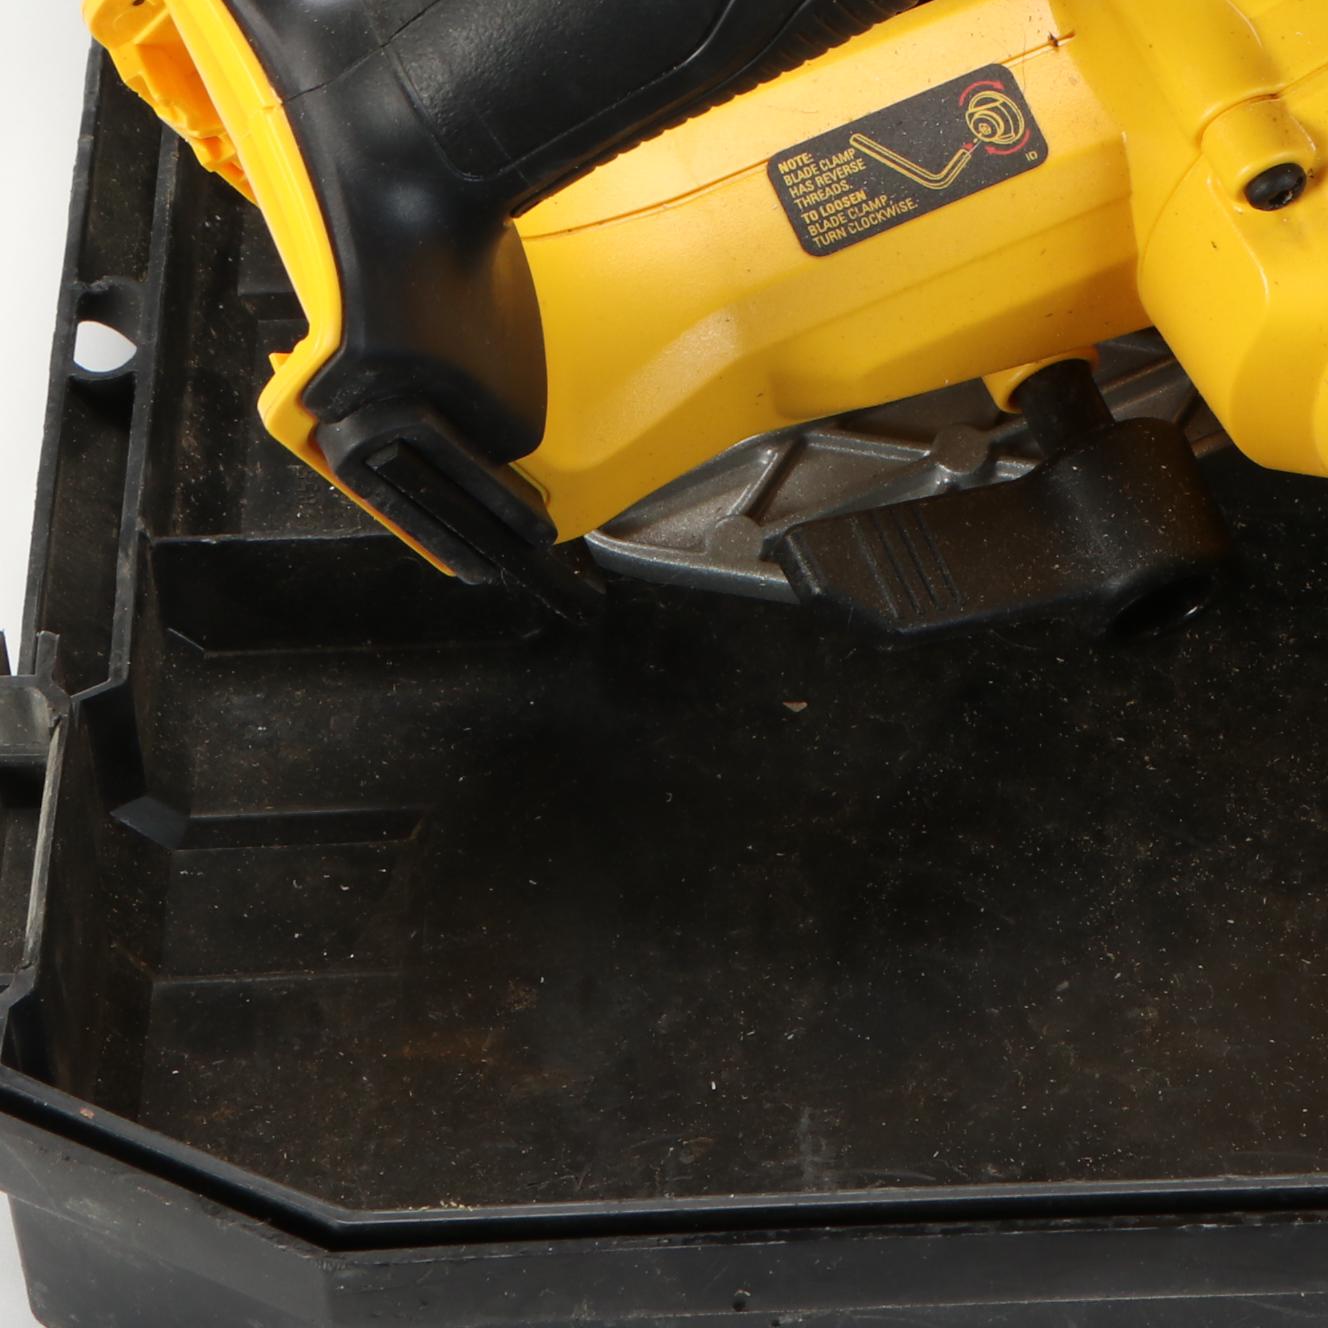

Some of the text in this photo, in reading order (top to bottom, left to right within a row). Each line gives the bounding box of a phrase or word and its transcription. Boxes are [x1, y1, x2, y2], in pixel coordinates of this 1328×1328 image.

[778, 152, 814, 174] NOTE:
[783, 148, 856, 186] BLADE CLAMP
[788, 158, 866, 198] HAS REVERSE
[794, 180, 853, 210] THREADS.
[801, 189, 867, 224] TO LOOSEN
[808, 212, 848, 236] BLADE
[812, 197, 918, 248] TURN CLOCKWISE.
